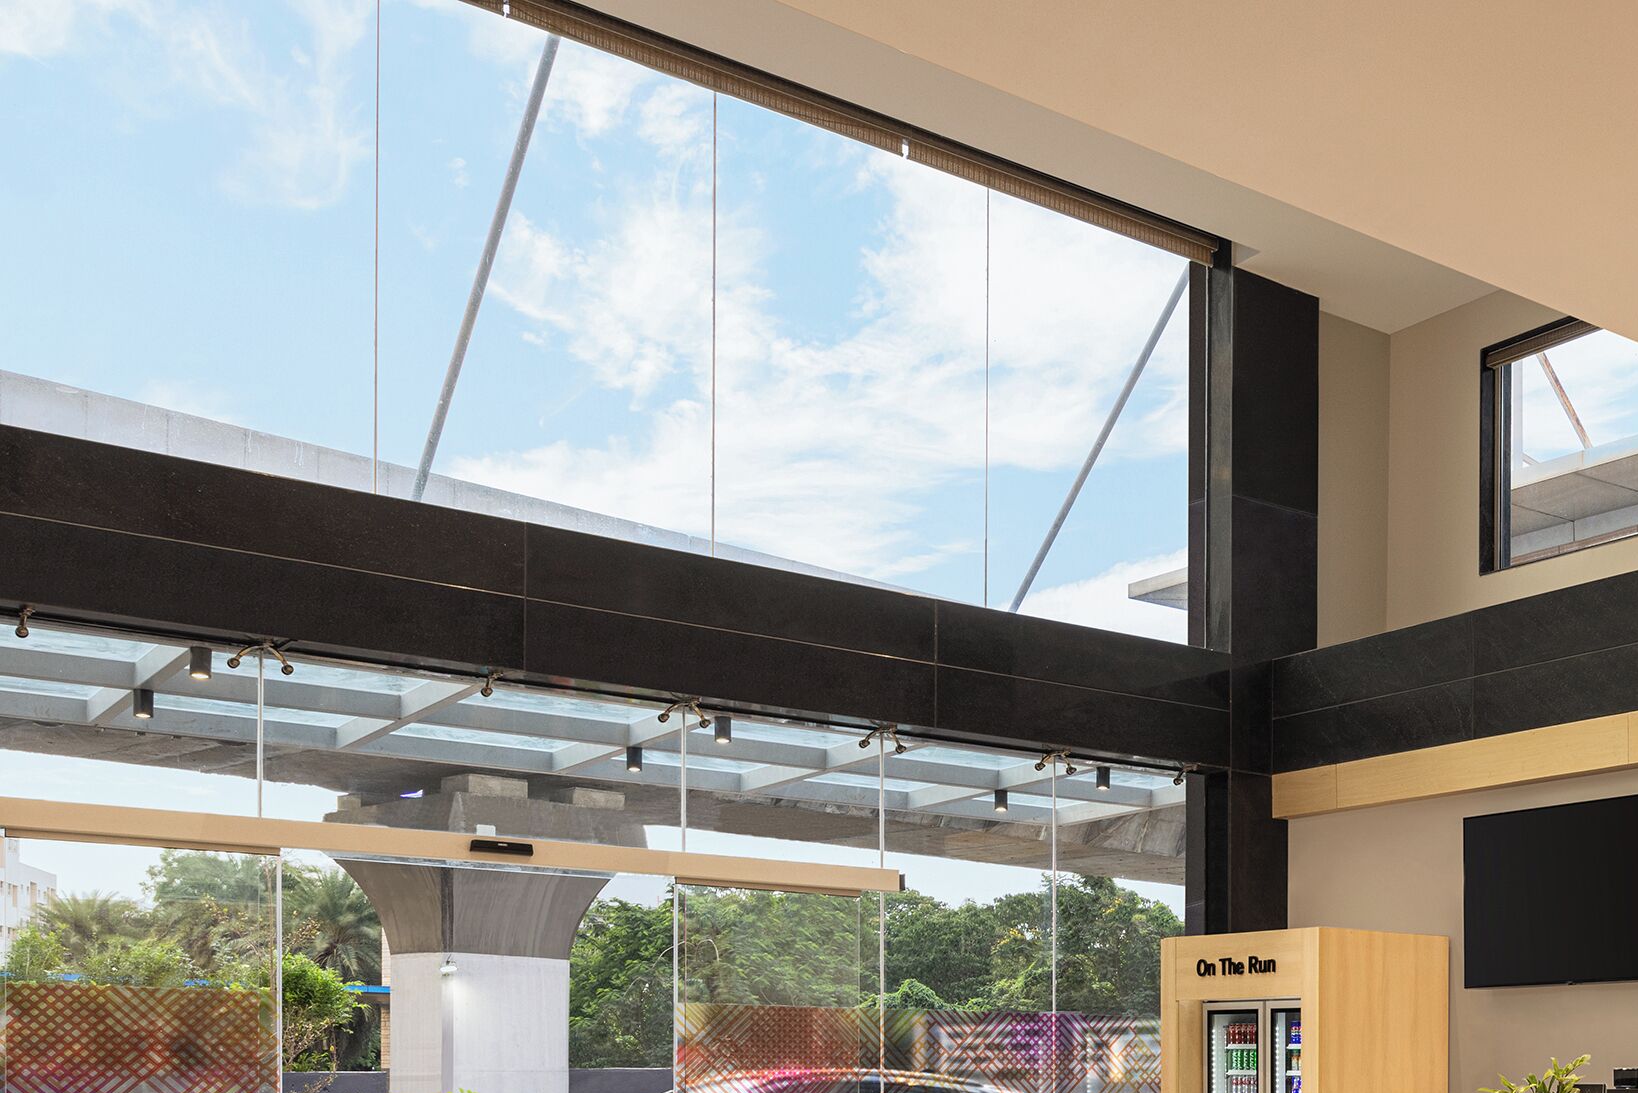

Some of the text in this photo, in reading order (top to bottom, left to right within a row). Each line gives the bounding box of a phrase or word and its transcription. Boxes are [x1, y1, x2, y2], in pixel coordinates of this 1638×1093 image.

[1196, 955, 1276, 977] On The Run
